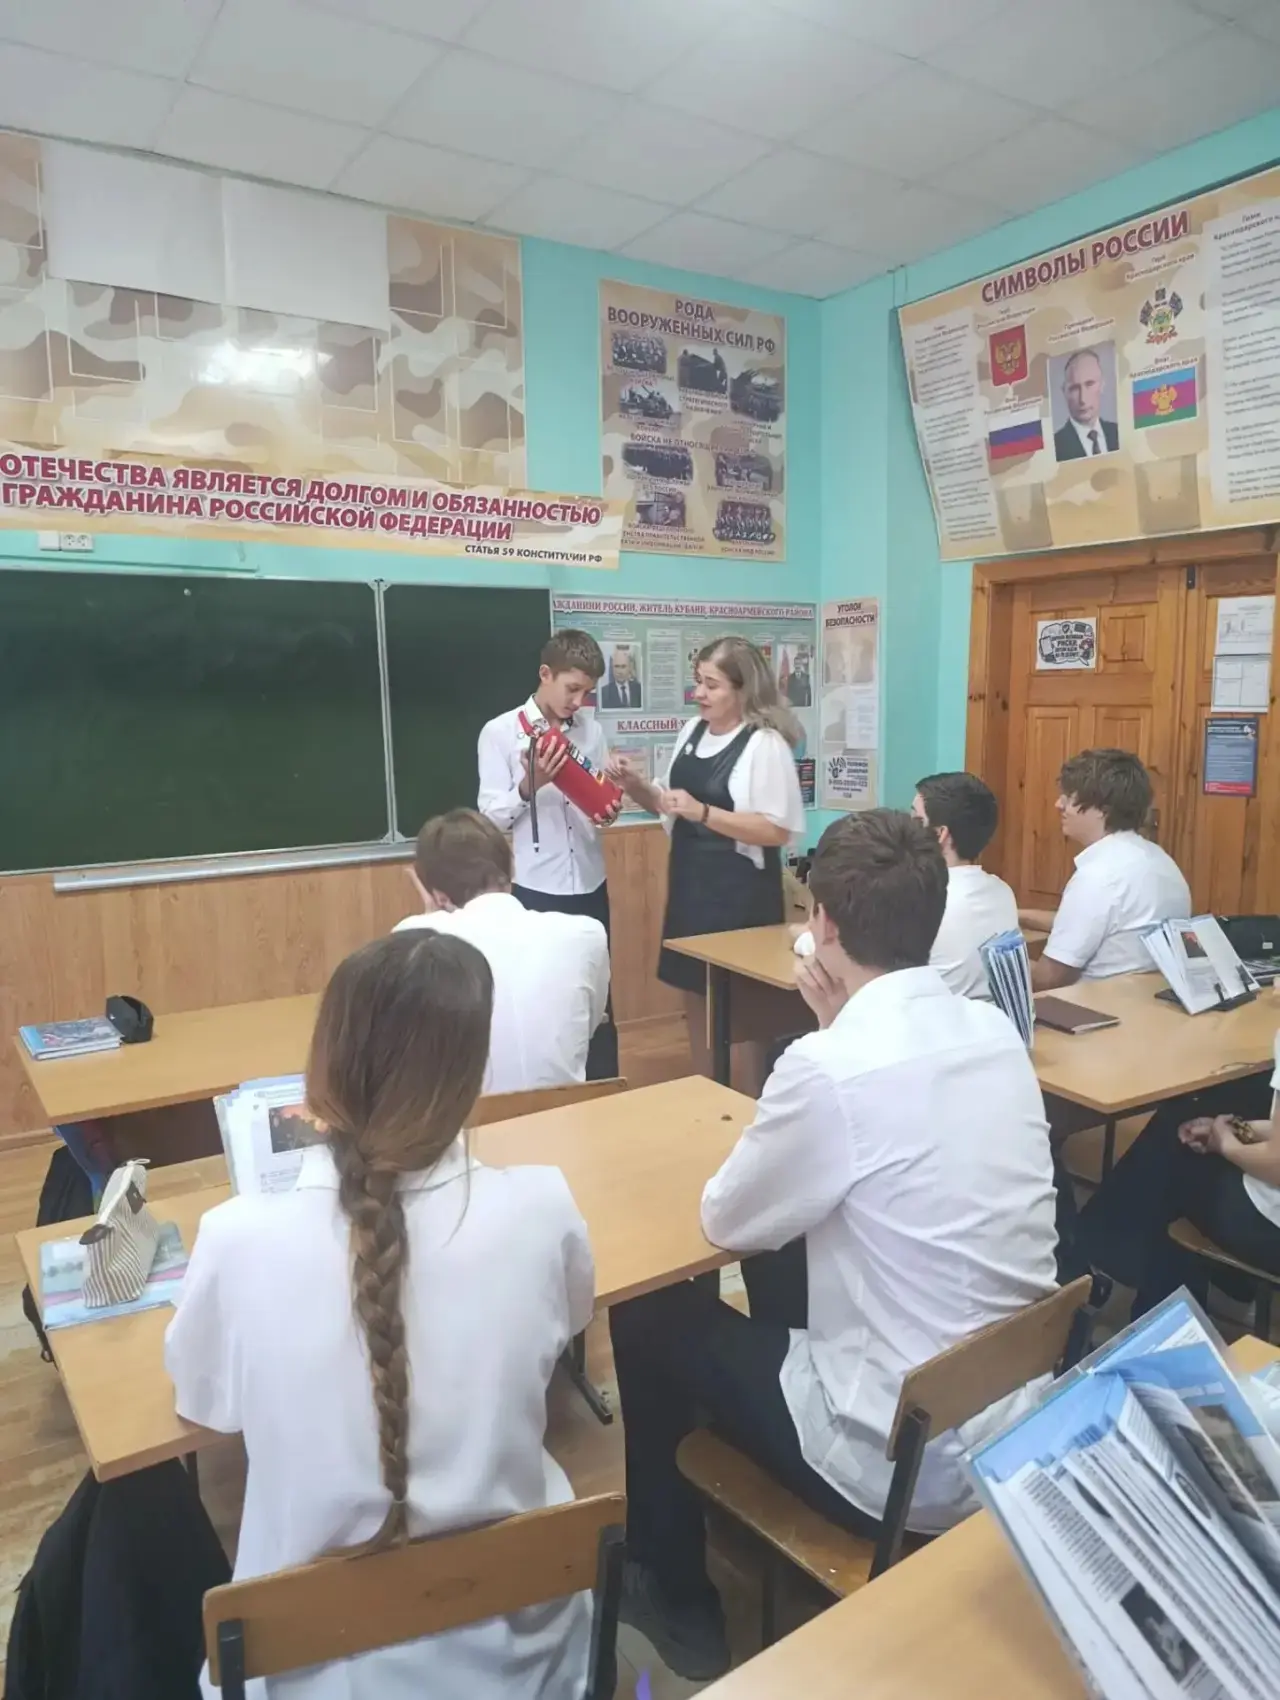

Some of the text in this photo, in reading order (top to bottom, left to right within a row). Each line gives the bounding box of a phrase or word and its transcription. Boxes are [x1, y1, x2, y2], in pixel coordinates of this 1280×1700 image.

[981, 249, 1086, 304] СИМВОЛЫ
[1091, 210, 1190, 266] РОССИИ
[675, 299, 715, 321] РОДА
[607, 306, 776, 354] ВООРУЖЕННЫХ СИЛ РФ
[0, 453, 601, 525] ОТЕЧЕСТВА ЯВЛЯЕТСЯ ДОЛГОМ И ОБЯЗАННОСТЬЮ
[2, 483, 512, 541] ГРАЖДАНИНА РОССИЙСКОЙ ФЕДЕРАЦИИ
[465, 545, 500, 556] СТАТЬЯ
[502, 547, 515, 557] 59
[588, 554, 603, 563] РФ
[639, 602, 673, 613] ЖИТЕЛЬ
[837, 602, 863, 614] УГОЛОК
[825, 614, 876, 628] БЕЗОПАСНОСТИ
[617, 718, 678, 731] КЛАССНЫЙ
